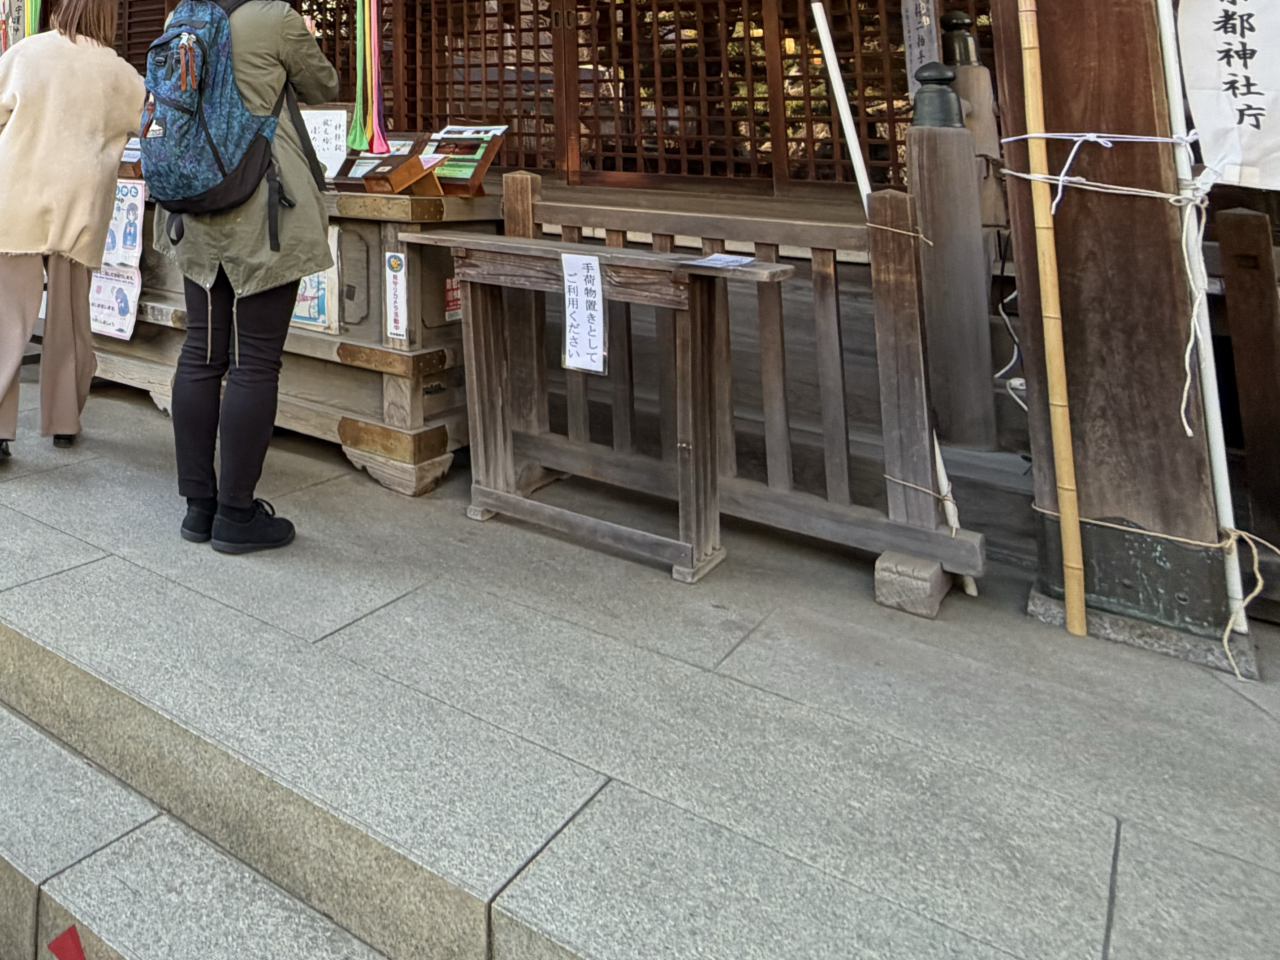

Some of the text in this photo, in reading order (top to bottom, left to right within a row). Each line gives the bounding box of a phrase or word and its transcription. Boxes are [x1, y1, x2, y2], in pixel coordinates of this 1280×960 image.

[566, 272, 581, 359] ご利用ください
[581, 262, 599, 364] 手荷物置きとして
